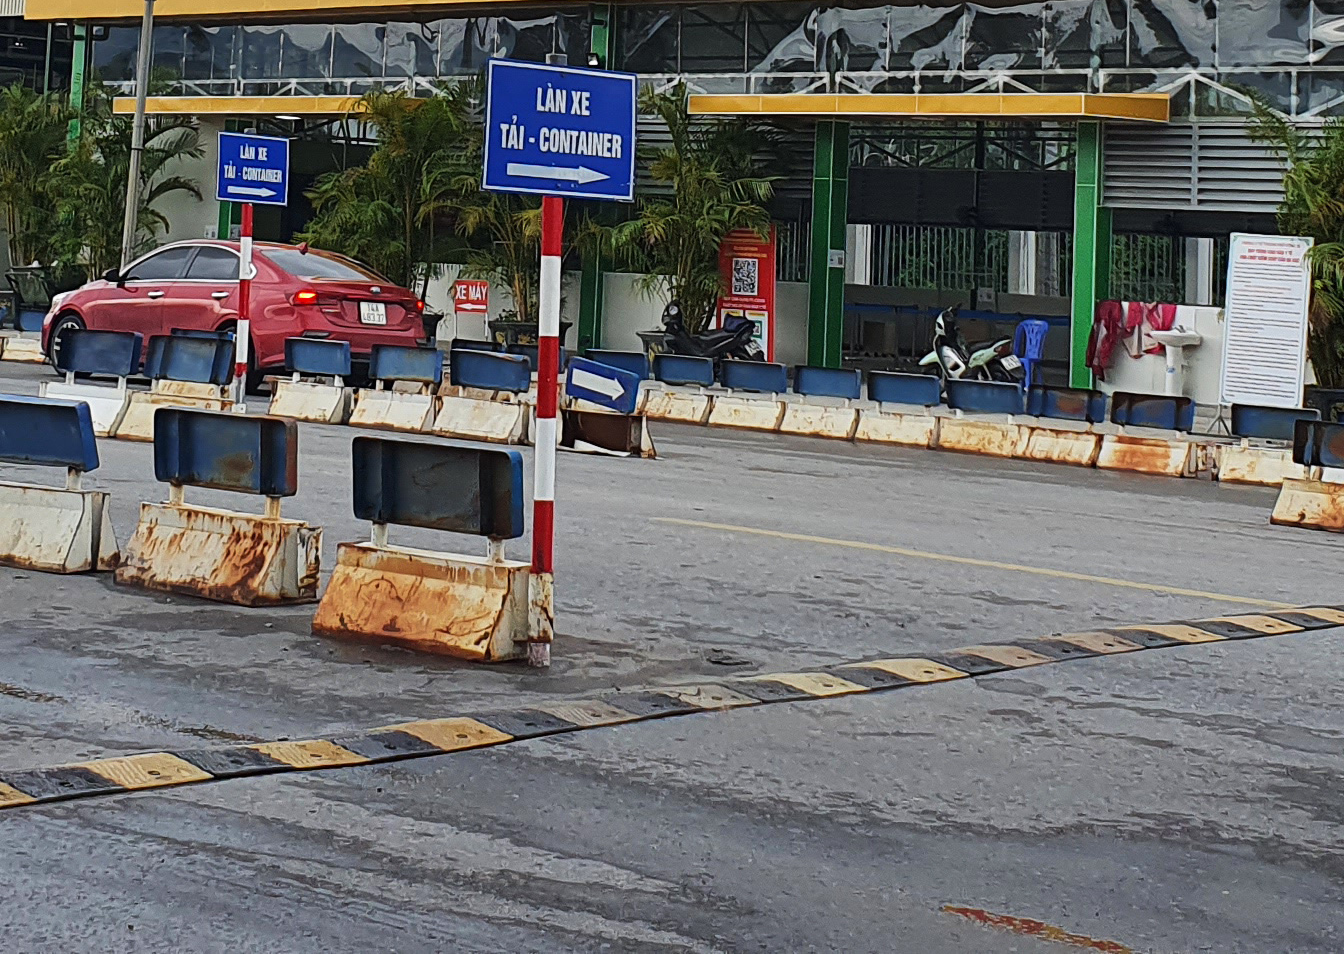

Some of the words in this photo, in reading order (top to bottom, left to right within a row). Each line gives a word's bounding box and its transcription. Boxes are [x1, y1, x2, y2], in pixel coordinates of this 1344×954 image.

[536, 82, 567, 114] LÀN
[570, 90, 590, 116] XE
[500, 114, 525, 150] TẢI
[539, 126, 622, 159] CONTAINER
[456, 285, 467, 300] XE
[469, 282, 487, 301] MÁY
